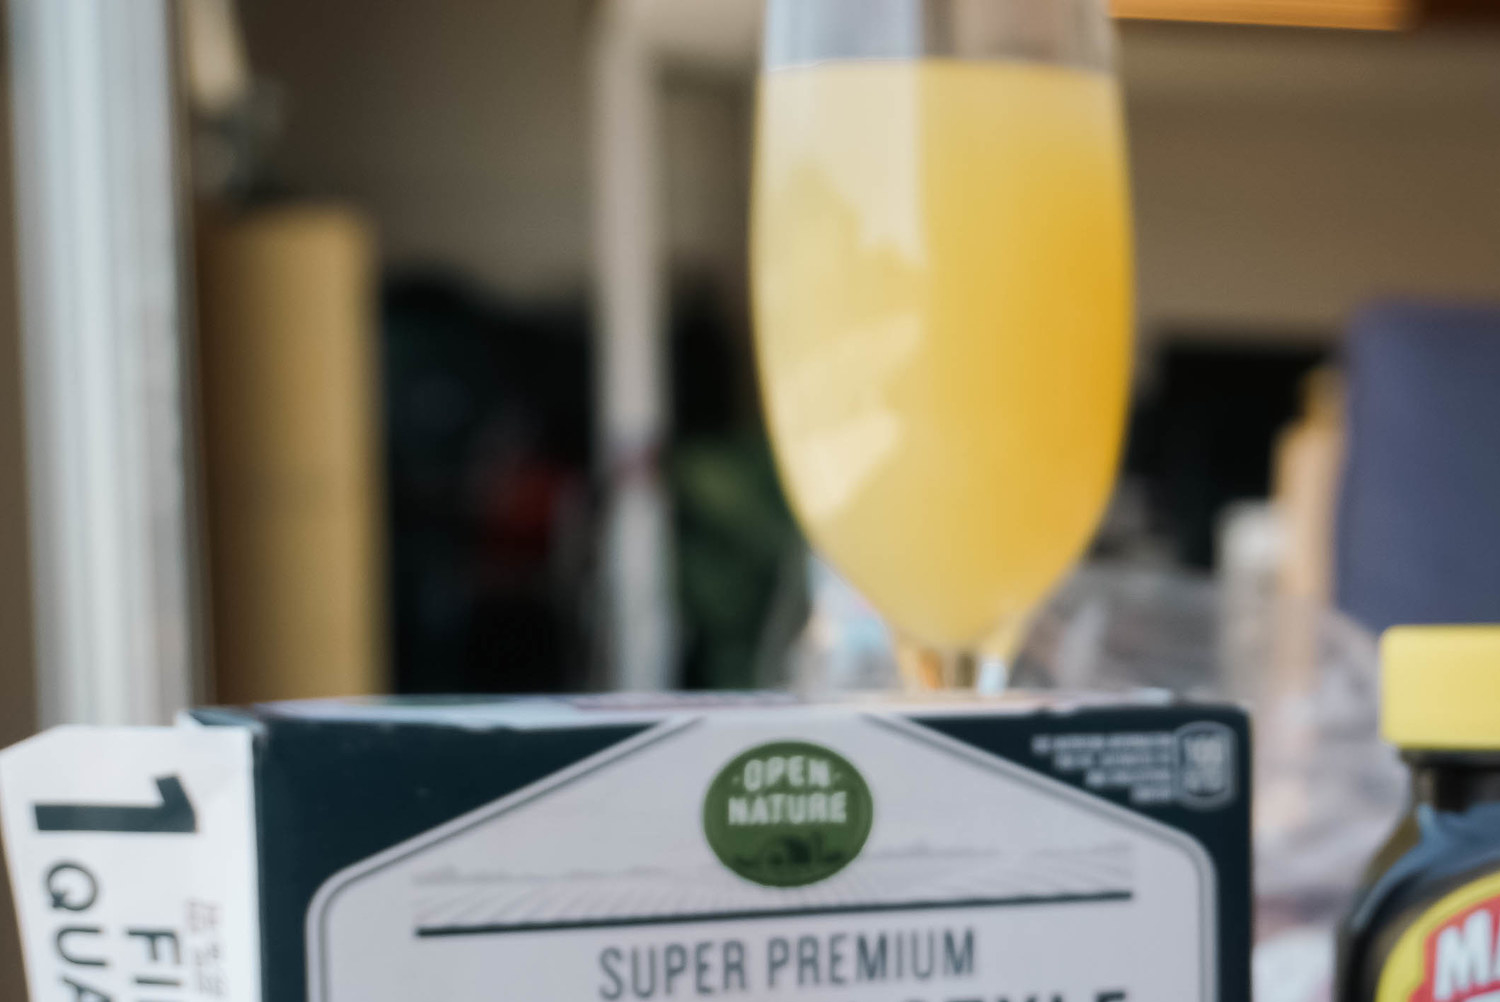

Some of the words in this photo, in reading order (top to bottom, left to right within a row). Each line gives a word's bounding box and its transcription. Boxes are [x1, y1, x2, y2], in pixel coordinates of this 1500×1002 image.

[744, 755, 831, 792] OPEN
[34, 774, 198, 833] 1
[727, 790, 847, 826] NATURE
[600, 939, 747, 1001] SUPER
[767, 926, 975, 989] PREMIUM
